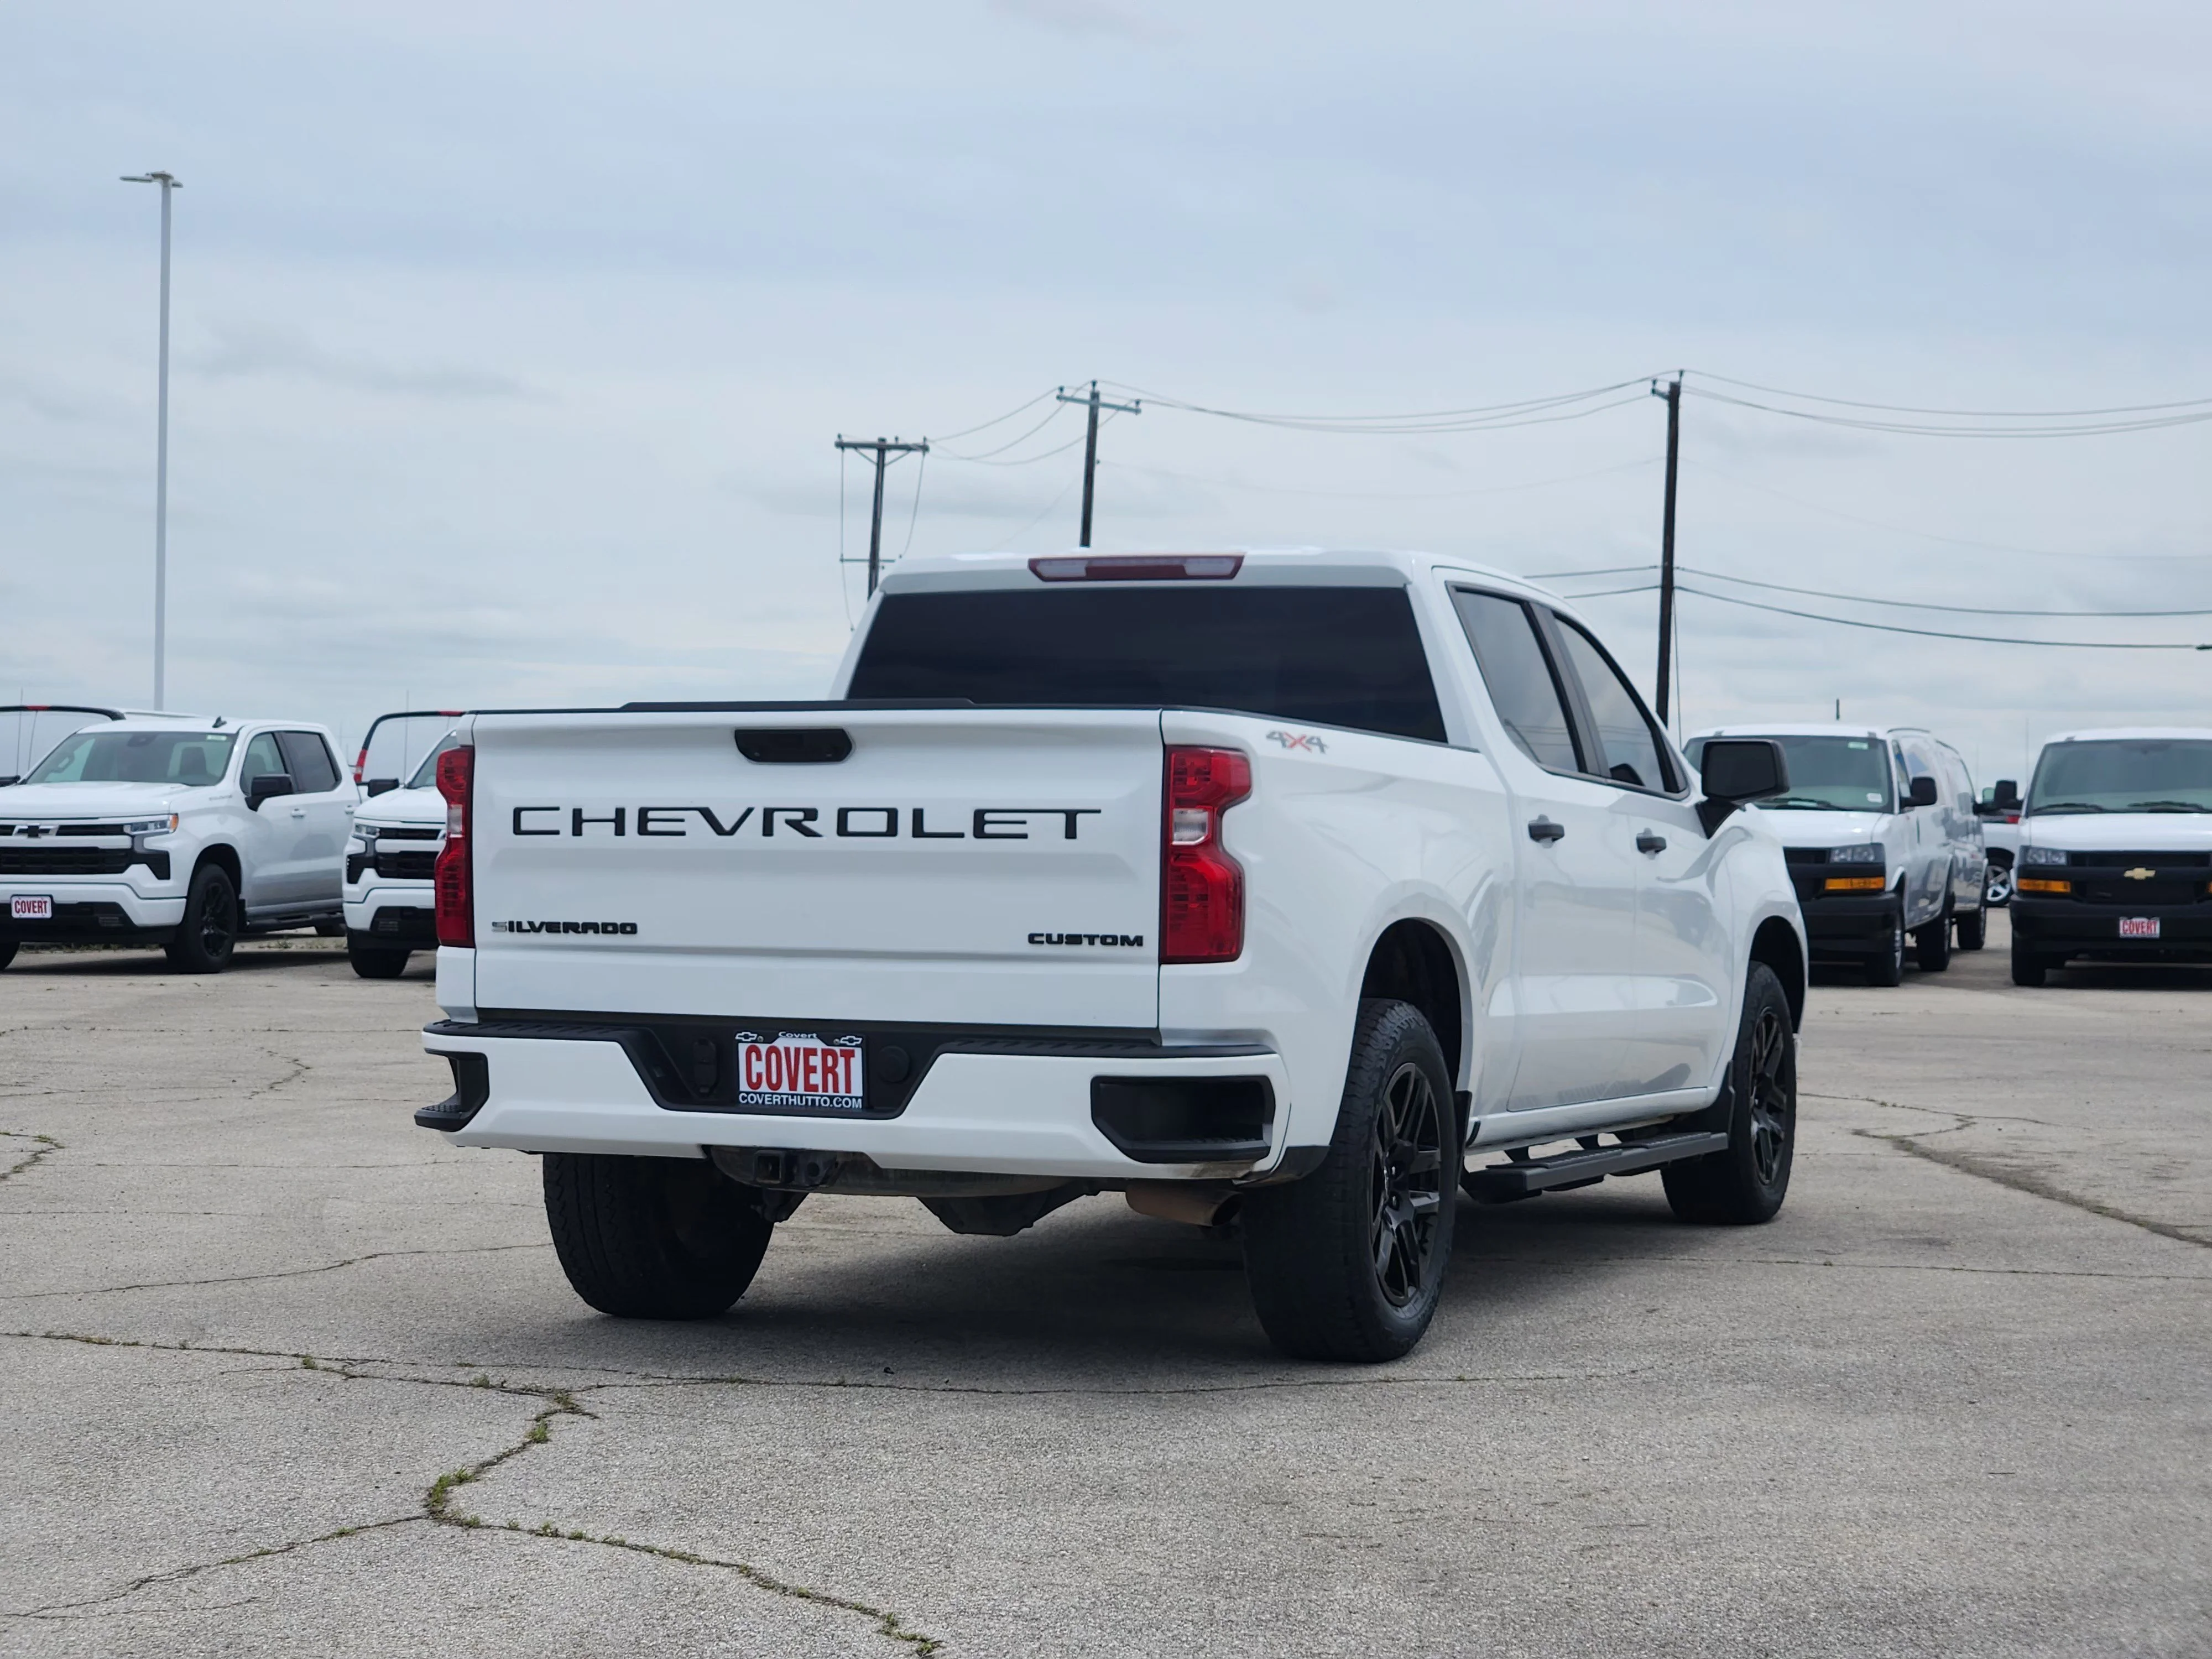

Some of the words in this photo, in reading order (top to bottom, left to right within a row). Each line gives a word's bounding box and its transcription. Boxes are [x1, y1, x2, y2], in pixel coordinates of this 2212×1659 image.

[513, 806, 1102, 839] CHEVROLET
[14, 900, 48, 914] COVERT
[492, 920, 638, 935] SILVERADO
[2122, 920, 2157, 935] COVERT
[1027, 932, 1144, 947] CUSTOM
[778, 1031, 818, 1039] Covert
[745, 1044, 855, 1094] COVERT
[739, 1093, 863, 1109] COVERTHUTTO.COM
